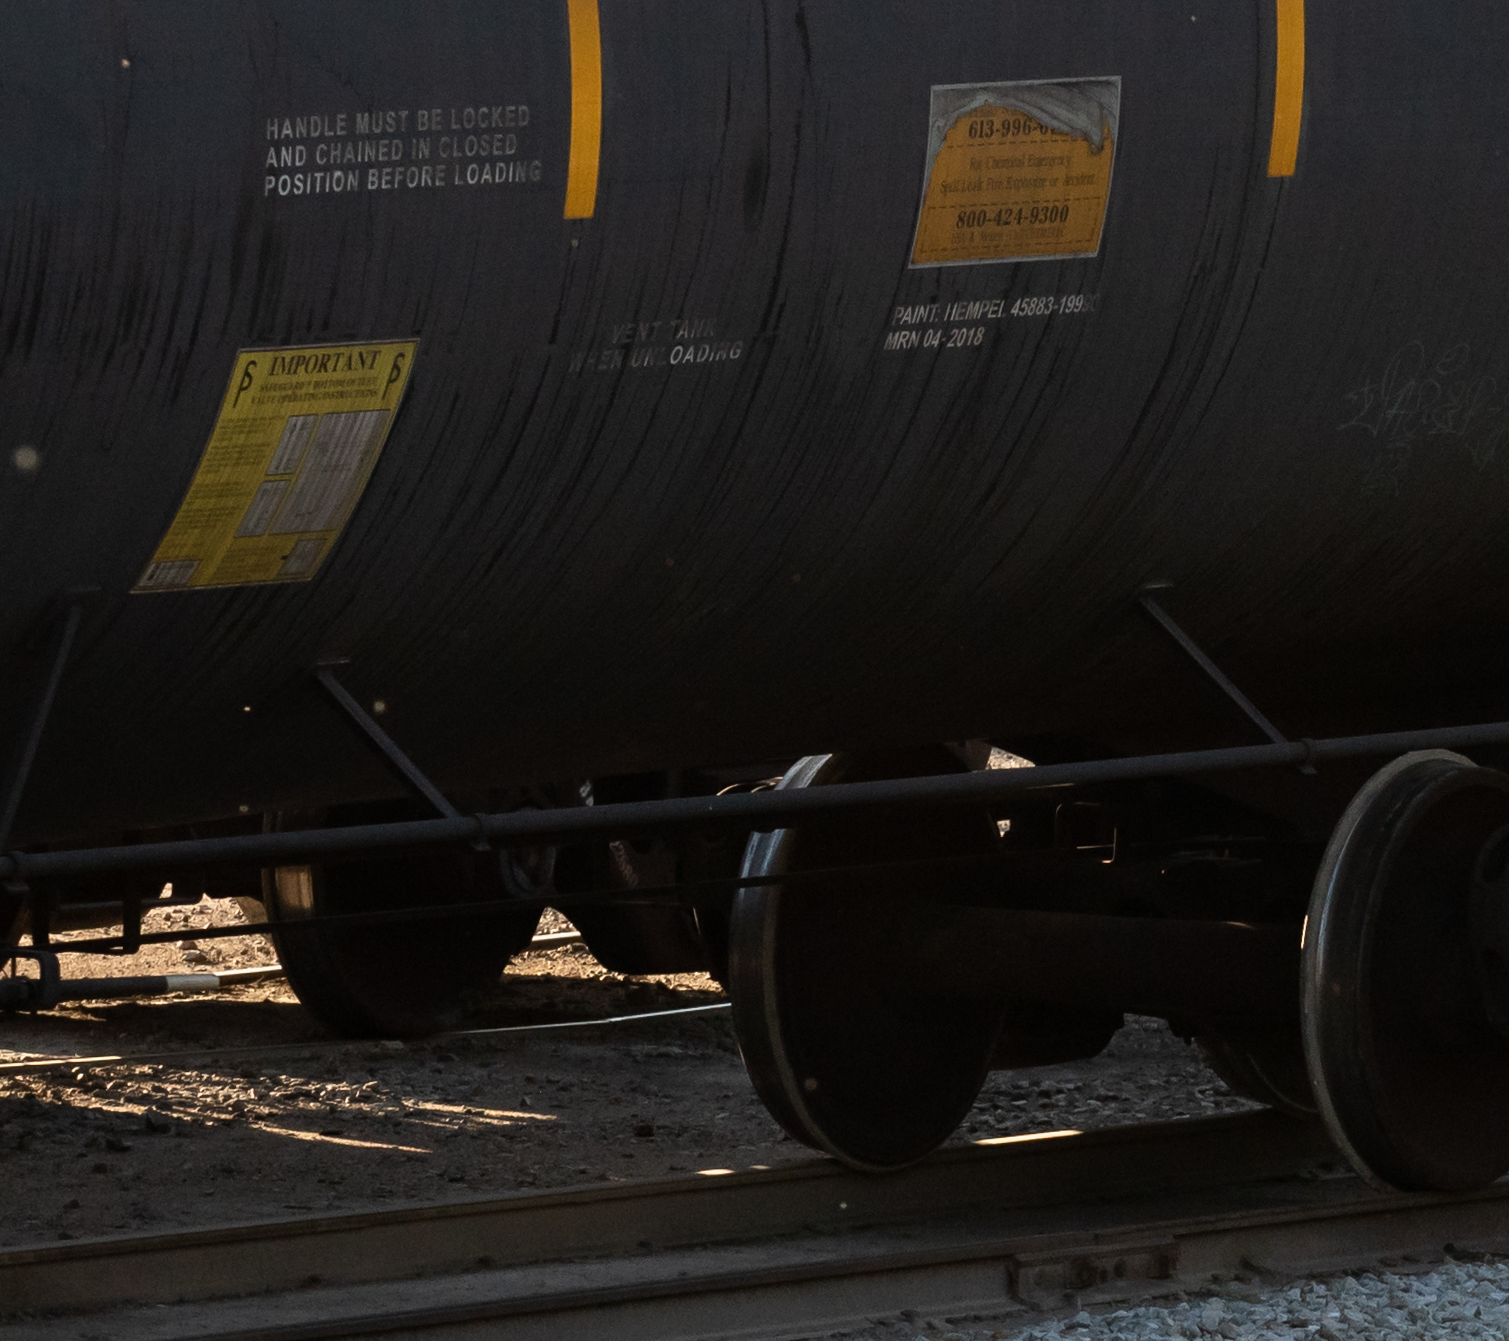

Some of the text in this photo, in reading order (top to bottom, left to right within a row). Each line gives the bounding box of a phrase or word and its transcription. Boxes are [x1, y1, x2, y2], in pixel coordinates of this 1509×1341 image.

[266, 105, 529, 139] HANDLE MUST BE LOCKED
[265, 134, 518, 168] AND CHAINED IN CLOSED
[264, 160, 541, 196] POSITION BEFORE LOADING
[956, 204, 1069, 229] 800-424-9300
[944, 300, 1007, 322] HEMPEL
[885, 330, 923, 350] MRN
[269, 350, 381, 376] IMPORTANT
